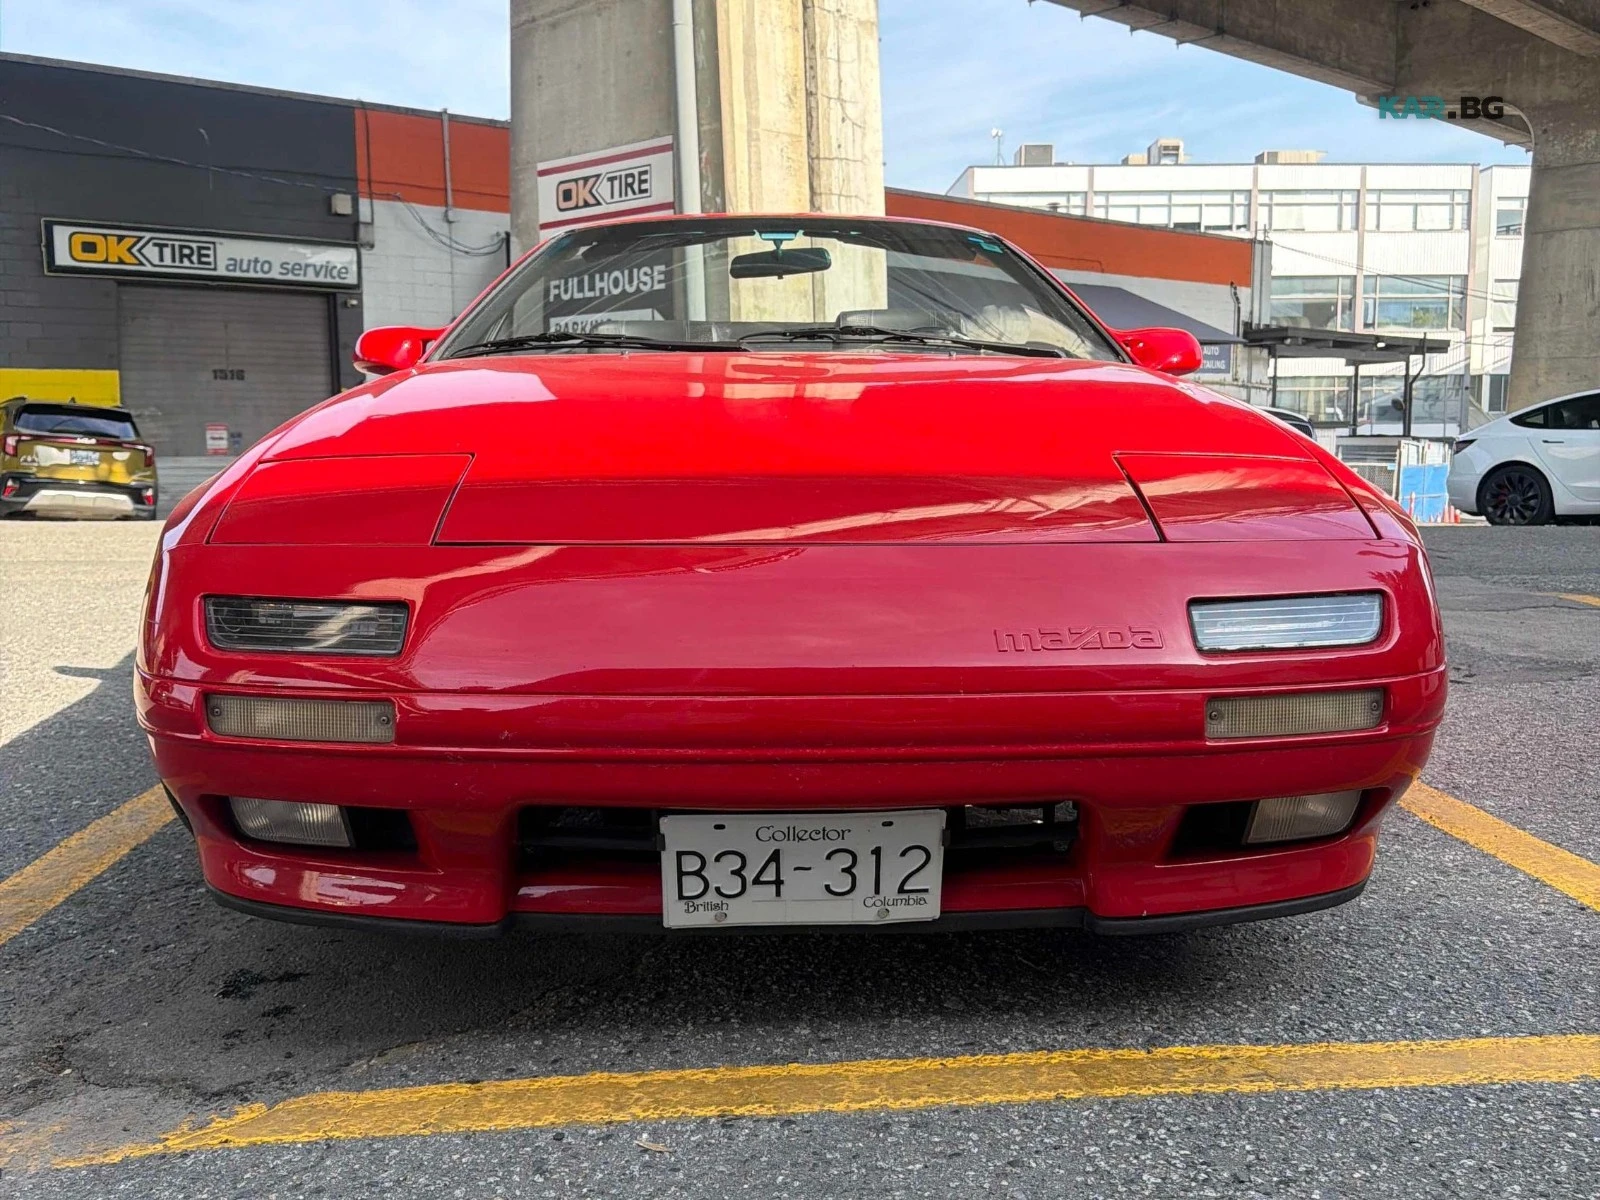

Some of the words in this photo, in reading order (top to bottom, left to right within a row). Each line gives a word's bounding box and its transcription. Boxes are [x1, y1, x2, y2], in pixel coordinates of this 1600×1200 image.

[557, 173, 602, 211] OK
[607, 170, 649, 200] TIRE
[70, 231, 143, 265] OK
[152, 242, 213, 267] TIRE
[226, 256, 272, 275] auto
[279, 260, 349, 280] service
[549, 265, 666, 302] FULLHOUSE
[1203, 346, 1219, 355] AUTO
[994, 625, 1164, 653] mazda
[756, 825, 851, 843] Collector
[676, 845, 932, 900] B34-312
[684, 900, 729, 914] British
[863, 895, 928, 908] Columbia
